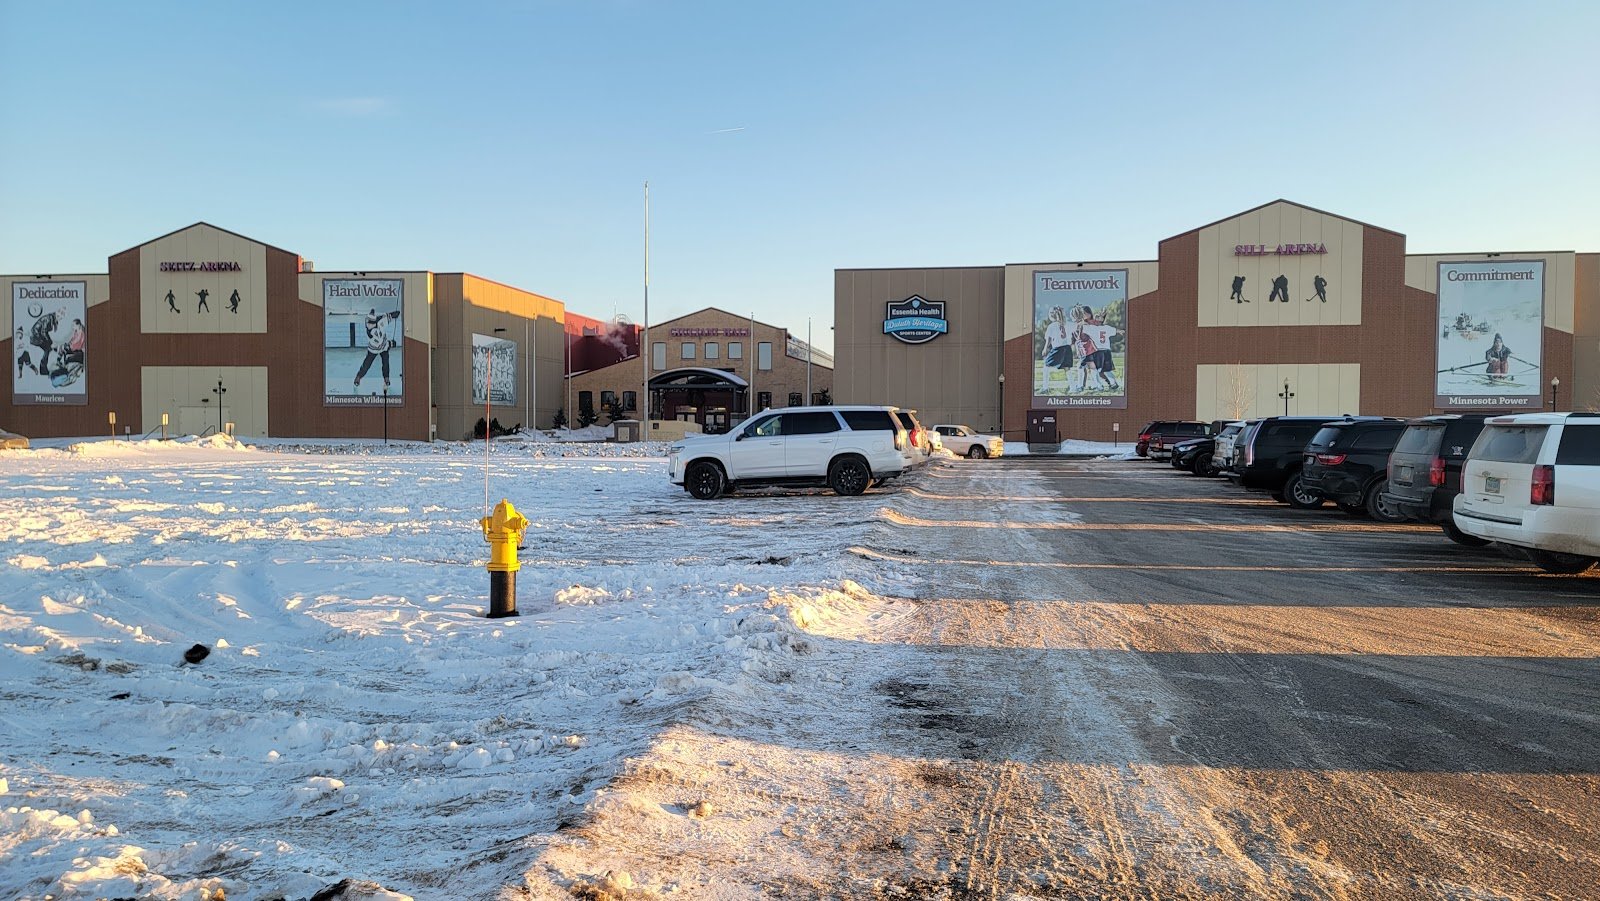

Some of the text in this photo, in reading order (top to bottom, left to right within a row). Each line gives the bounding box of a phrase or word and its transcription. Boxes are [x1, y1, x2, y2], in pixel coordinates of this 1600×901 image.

[1235, 243, 1328, 256] SILL ARENA
[200, 262, 241, 272] ARENA
[1447, 269, 1534, 282] Commitment
[1041, 276, 1120, 290] Teamwork
[19, 286, 79, 300] Dedication
[329, 284, 397, 297] Hard Work
[887, 319, 943, 329] Duluth Heritage
[1099, 330, 1106, 344] 5
[35, 394, 65, 403] Maurices
[325, 396, 402, 404] Minnesota Wildeness
[1046, 397, 1112, 406] Altec Industries
[1449, 396, 1528, 405] Minnesota Power
